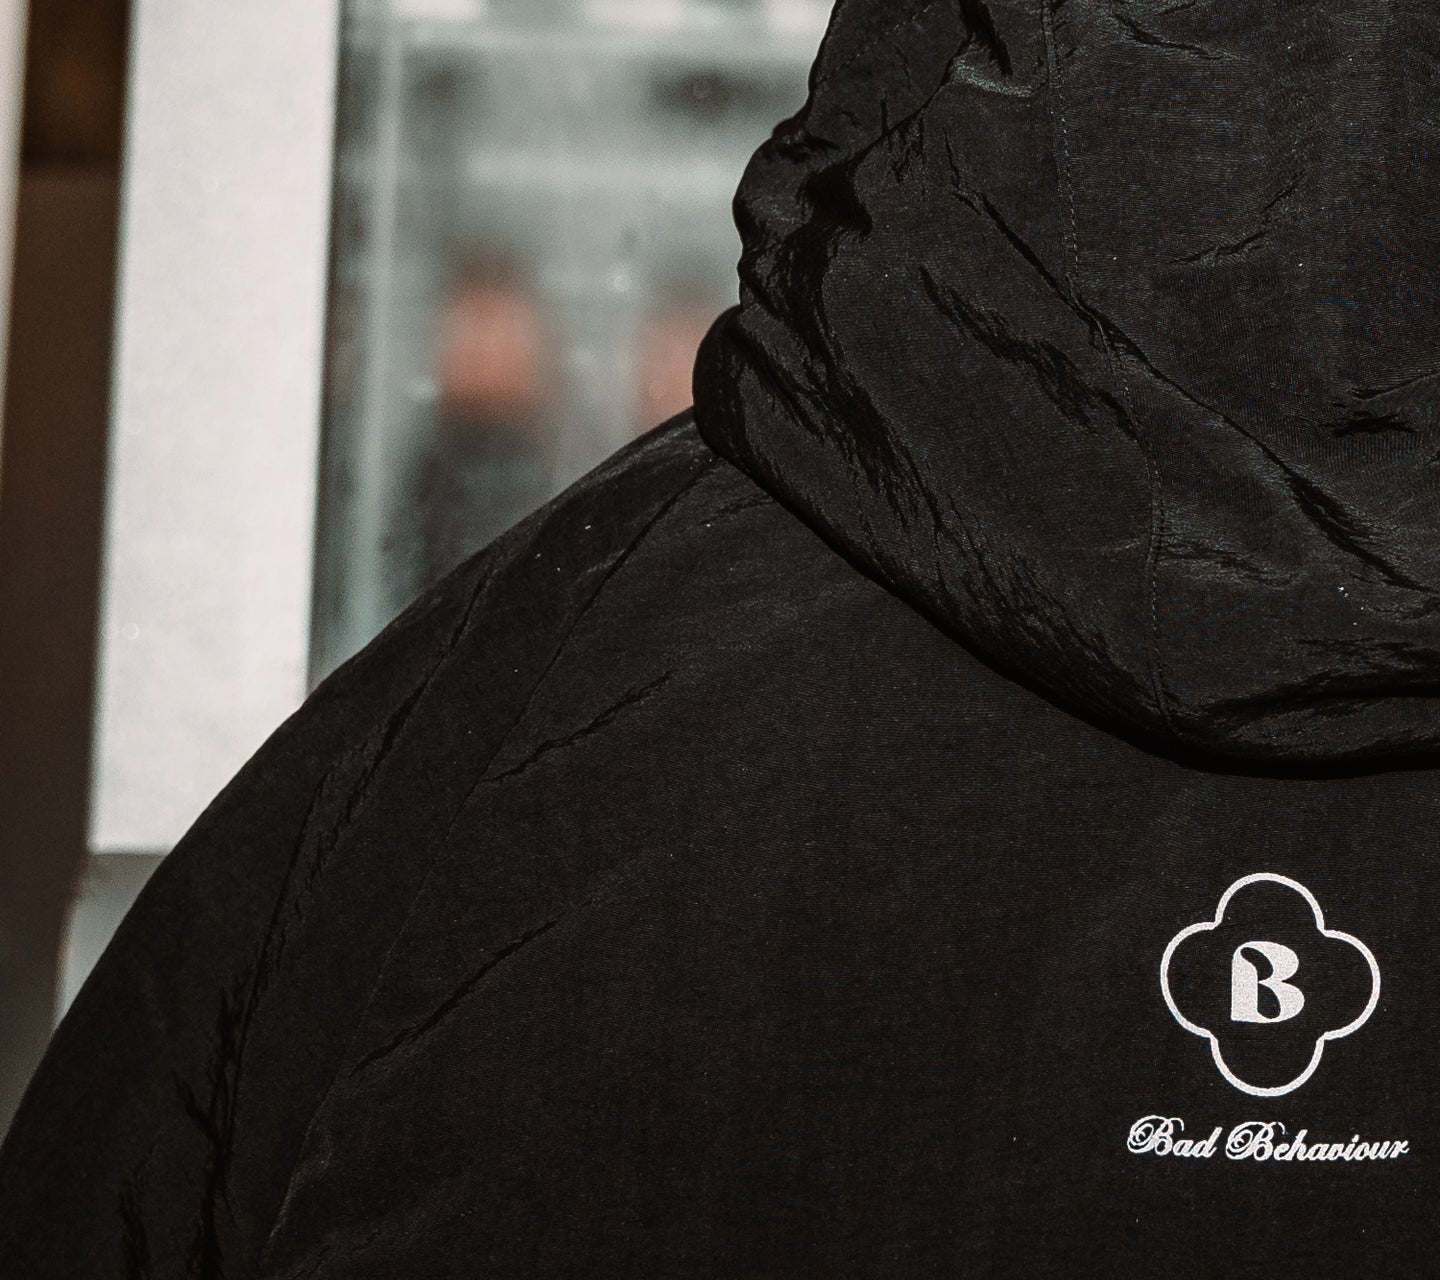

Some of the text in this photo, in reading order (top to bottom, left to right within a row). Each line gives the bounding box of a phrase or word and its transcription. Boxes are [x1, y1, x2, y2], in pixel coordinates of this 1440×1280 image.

[1231, 941, 1305, 1023] B
[1127, 1115, 1410, 1161] Bad Behaviour
